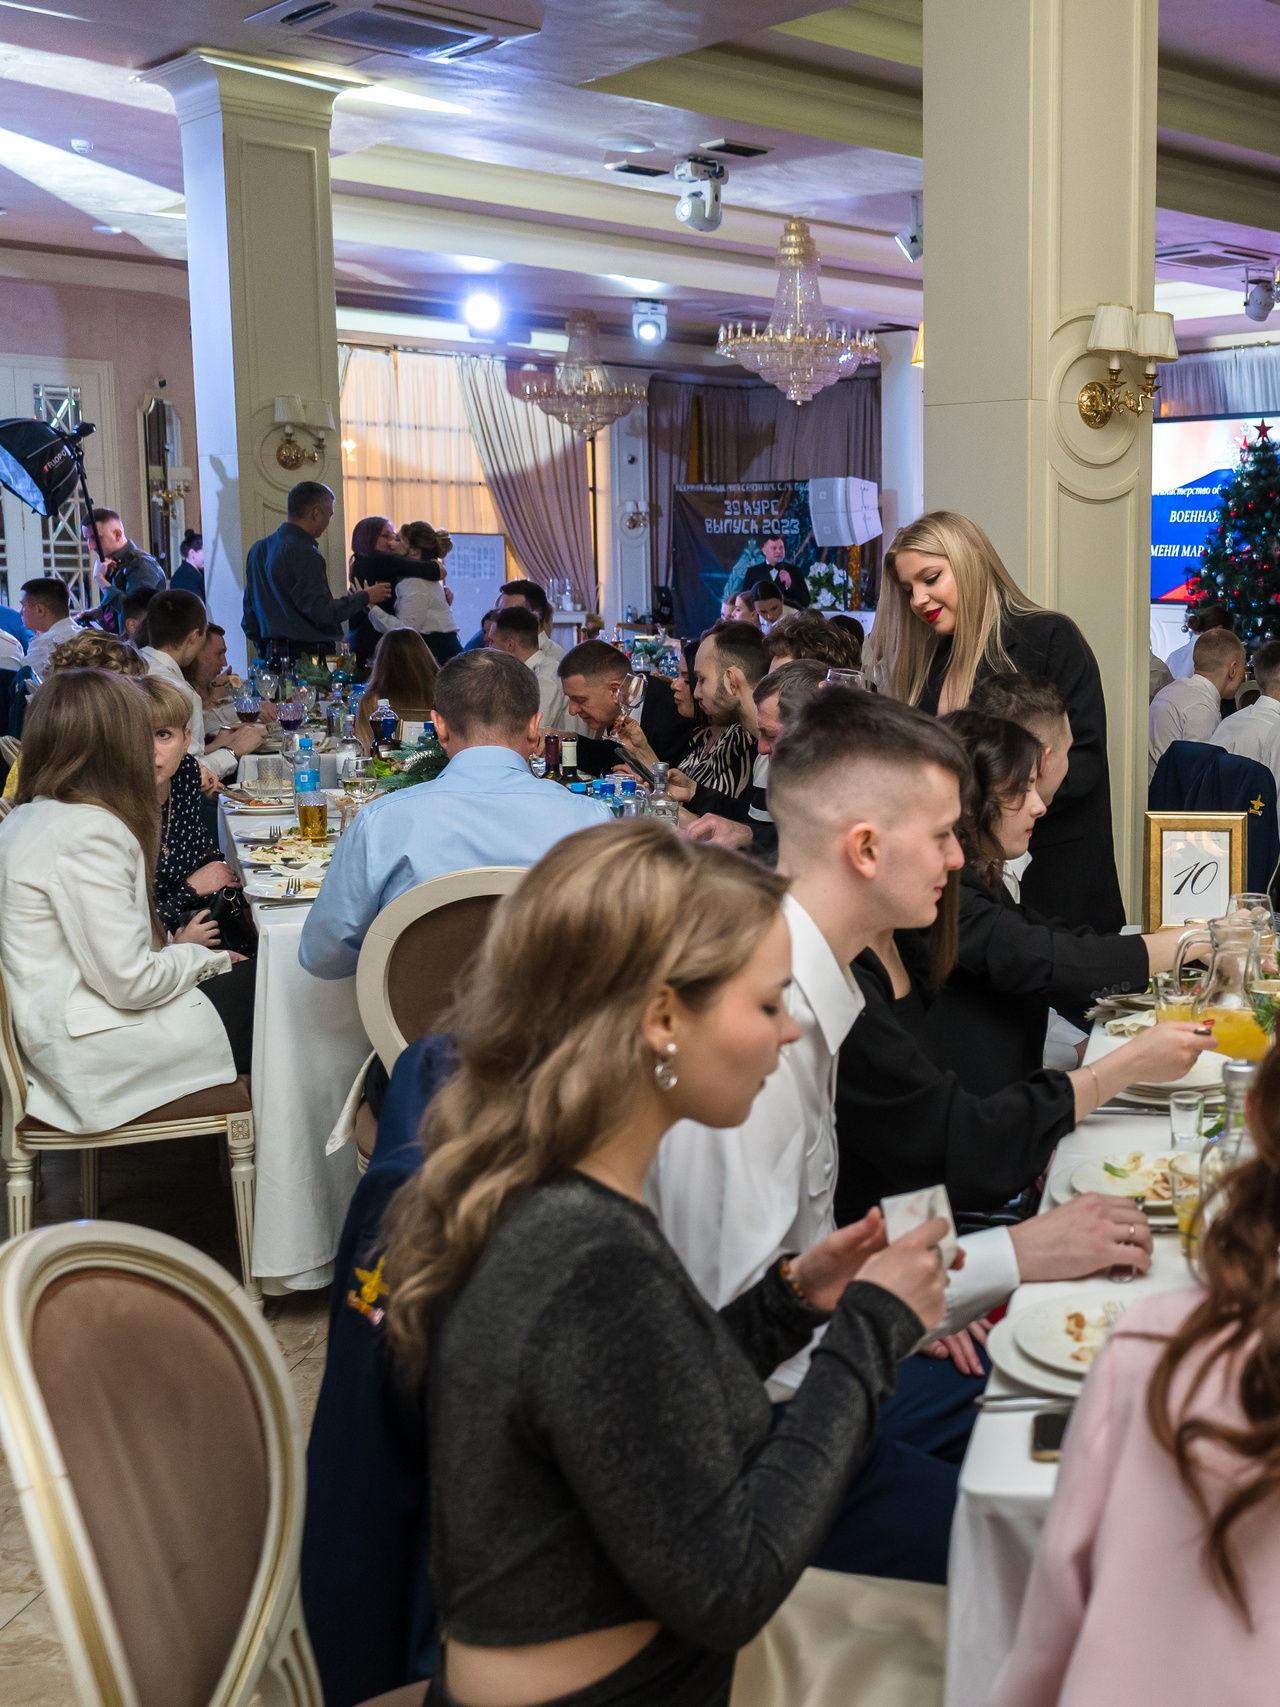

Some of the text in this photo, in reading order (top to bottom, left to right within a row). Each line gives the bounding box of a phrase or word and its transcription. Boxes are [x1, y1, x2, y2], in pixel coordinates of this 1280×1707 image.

[724, 500, 741, 516] 39
[1169, 510, 1219, 523] ВОЕННАЯ
[762, 518, 800, 535] 2023
[1172, 861, 1219, 896] 10
